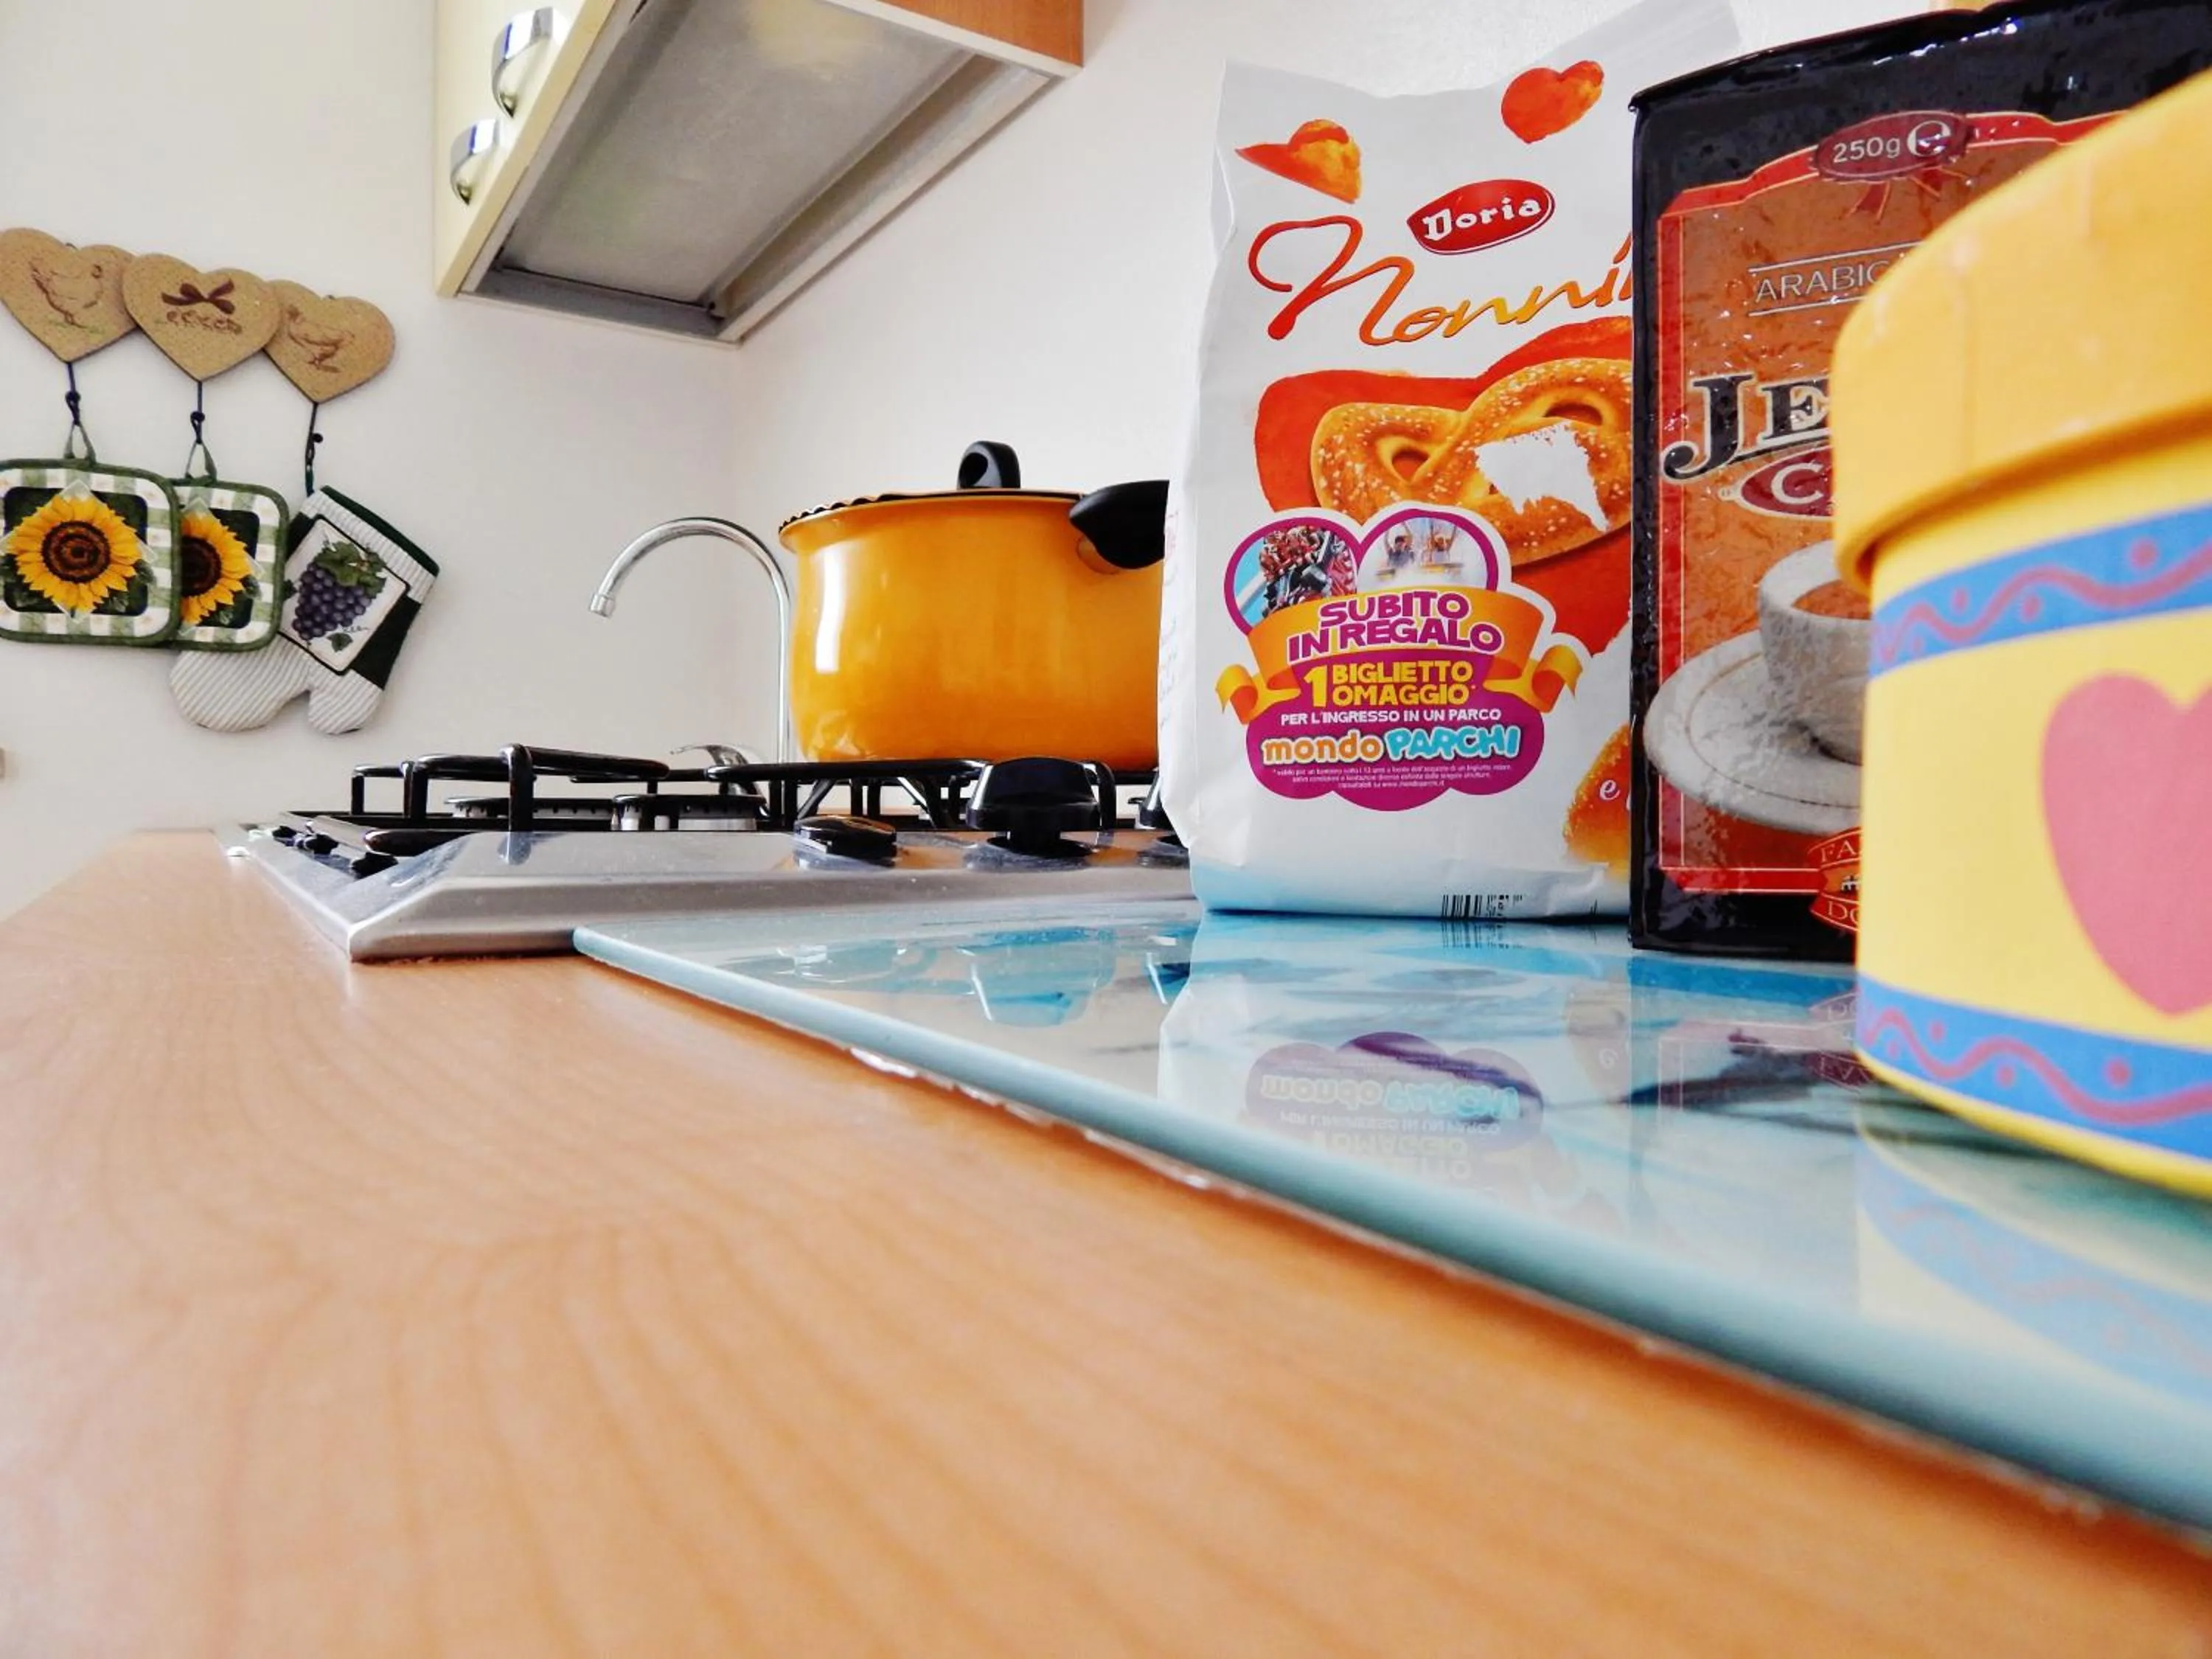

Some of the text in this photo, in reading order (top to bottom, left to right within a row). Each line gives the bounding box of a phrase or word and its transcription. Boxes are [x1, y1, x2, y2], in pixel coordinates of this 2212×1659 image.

[1832, 136, 1900, 164] 250g
[1422, 197, 1542, 241] Doria
[1248, 215, 1632, 346] Nonni
[1755, 260, 1891, 303] ARABIC
[1661, 370, 1831, 484] JE
[1318, 590, 1471, 626] SUBITO
[1287, 616, 1506, 665] IN REGALO
[1304, 661, 1474, 708] 1 BIGLIETTO
[1281, 708, 1502, 726] PER L'INGRESSO IN UN PARCO
[1262, 725, 1521, 763] mondo PARCHI
